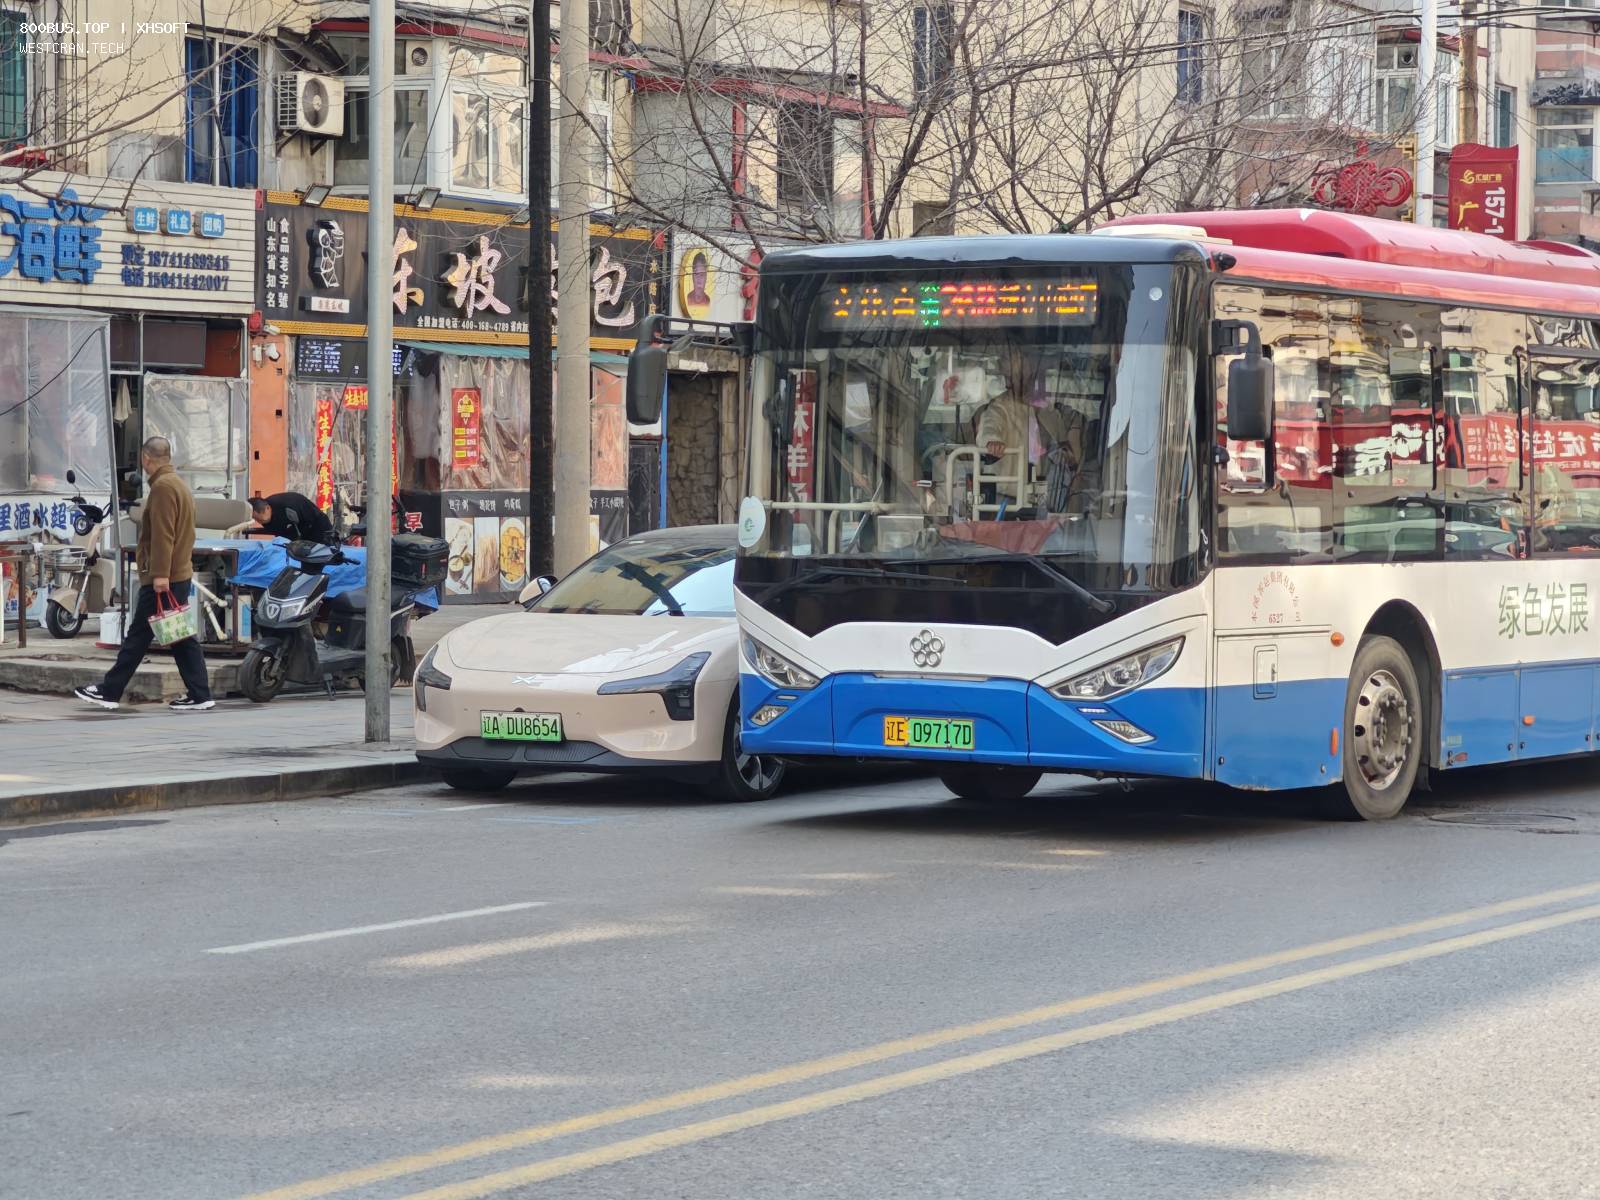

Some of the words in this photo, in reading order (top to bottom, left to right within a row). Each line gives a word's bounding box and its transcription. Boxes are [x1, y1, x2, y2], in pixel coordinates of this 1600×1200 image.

[170, 214, 189, 230] 礼盒
[204, 217, 222, 232] 团购
[266, 217, 277, 308] 山东省知名
[121, 265, 144, 287] 电话
[404, 512, 423, 532] 早
[1498, 582, 1588, 639] 绿色发展
[507, 717, 558, 737] DU8654
[913, 722, 972, 745] 09717D
